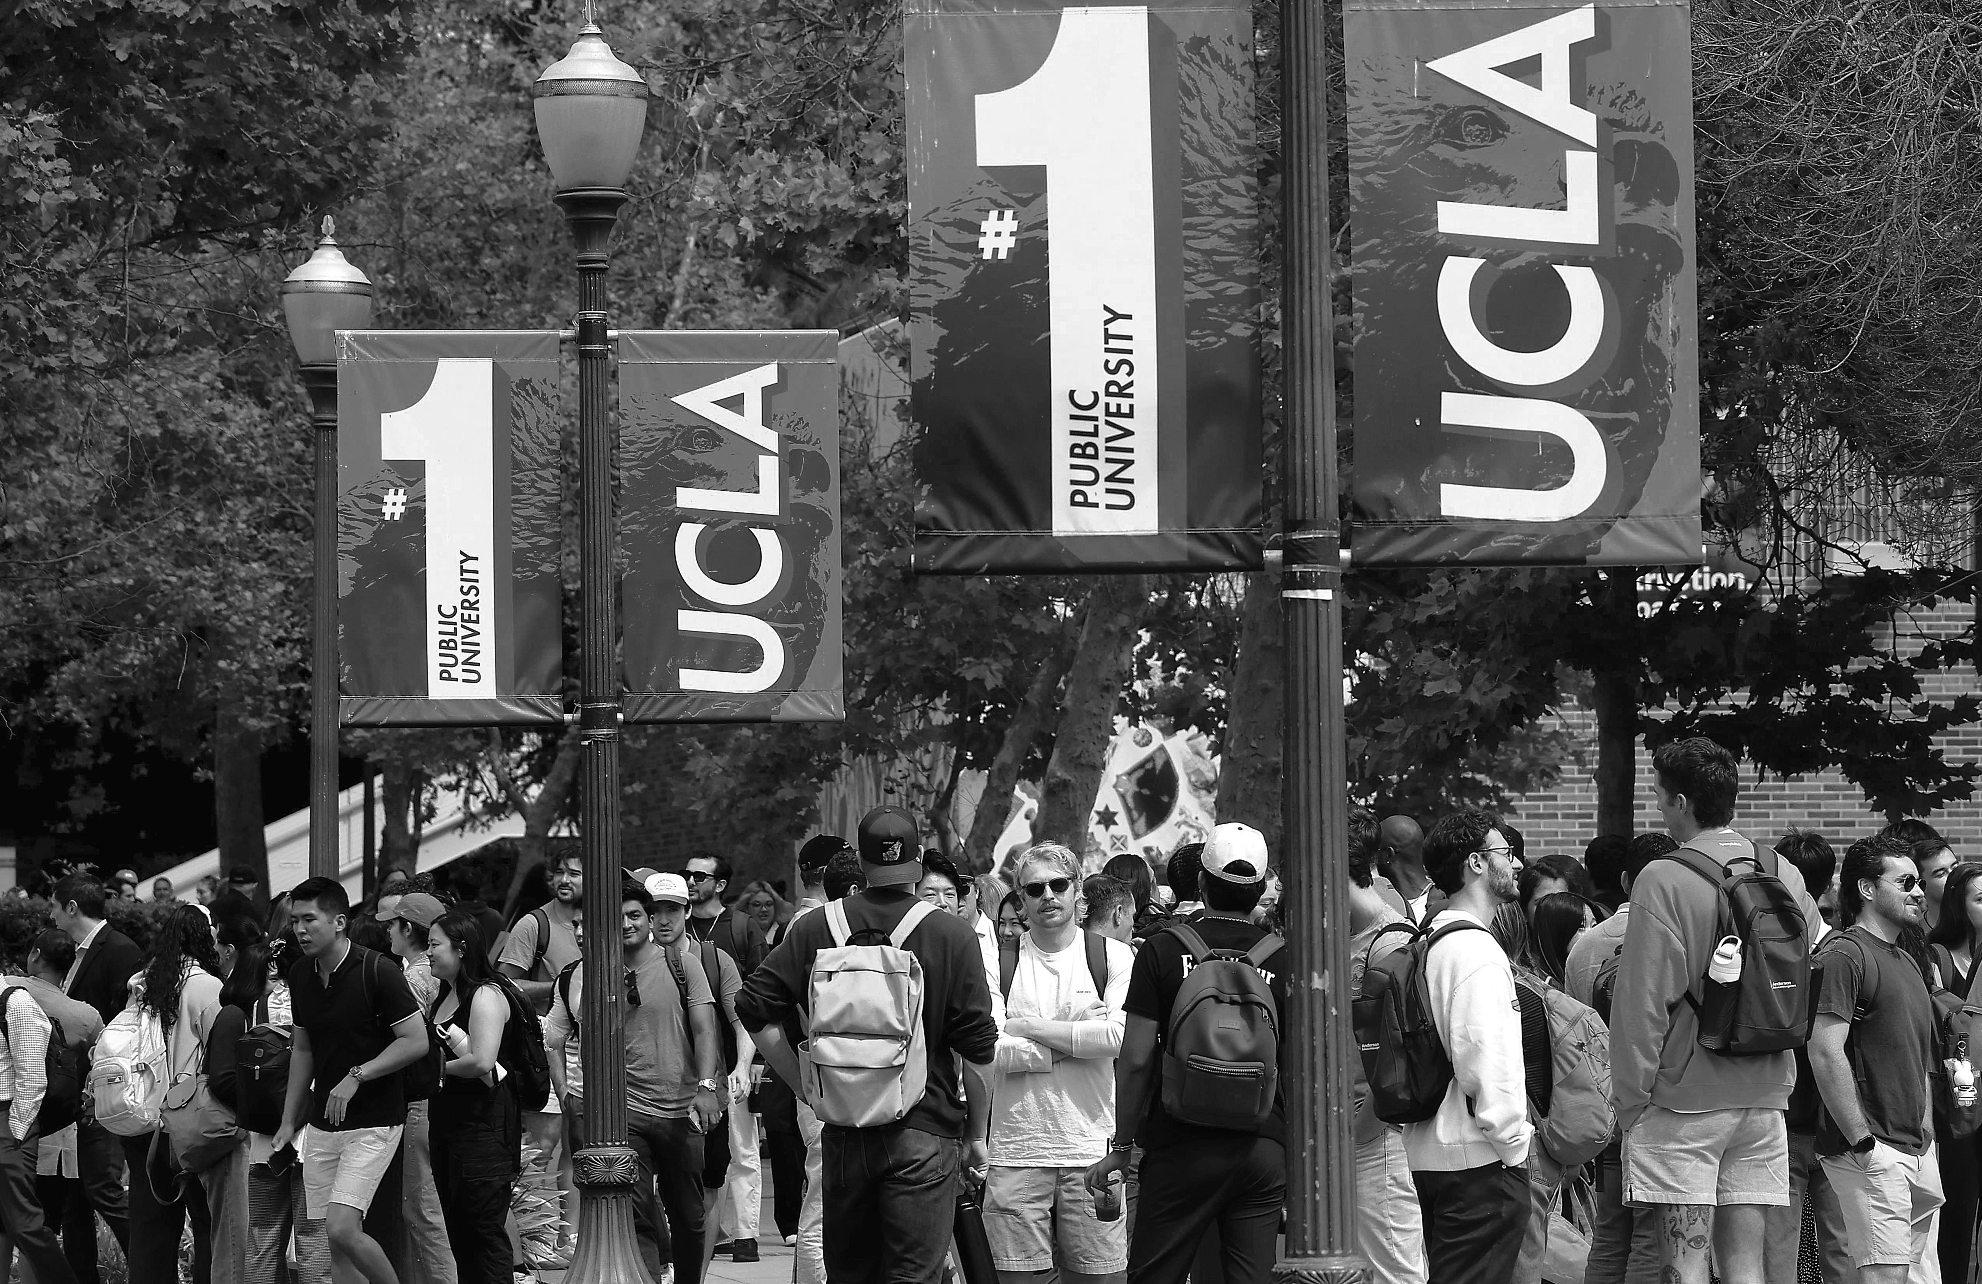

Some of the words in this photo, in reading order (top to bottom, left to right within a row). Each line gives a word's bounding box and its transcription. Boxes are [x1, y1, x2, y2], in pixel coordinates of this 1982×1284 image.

[1425, 4, 1607, 522] UCLA
[1069, 389, 1100, 509] PUBLIC
[1102, 303, 1136, 511] UNIVERSITY
[670, 361, 785, 694] UCLA
[437, 604, 459, 682] PUBLIC
[459, 549, 482, 684] UNIVERSITY
